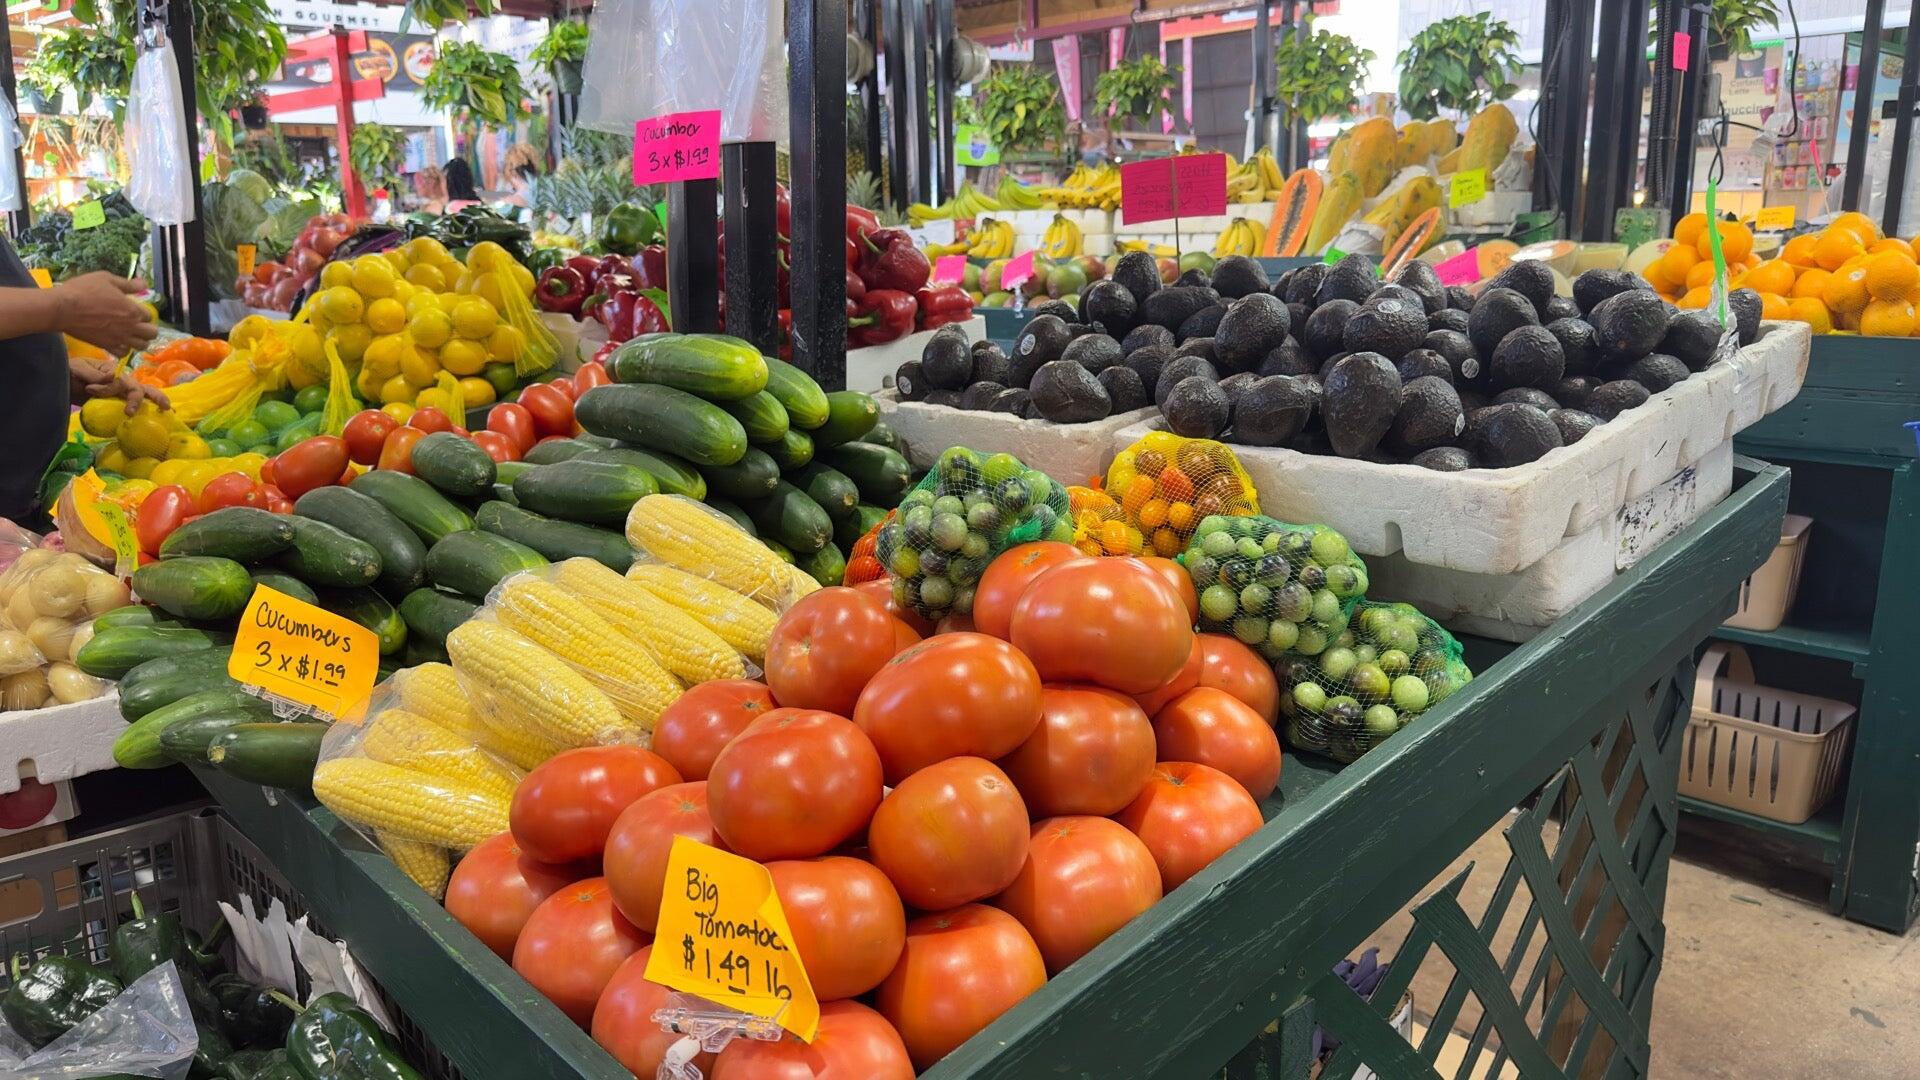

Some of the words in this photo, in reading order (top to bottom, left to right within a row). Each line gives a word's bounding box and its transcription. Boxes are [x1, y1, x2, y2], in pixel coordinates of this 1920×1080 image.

[295, 10, 381, 26] GOURMET
[648, 151, 661, 172] 3
[673, 146, 710, 171] $1.99
[255, 601, 351, 653] Cucumbers
[254, 640, 273, 668] 3
[295, 653, 347, 687] $1.99
[686, 867, 719, 917] Big
[694, 911, 789, 952] Tomatoe
[682, 933, 751, 995] $1.49
[765, 959, 793, 1001] lb
